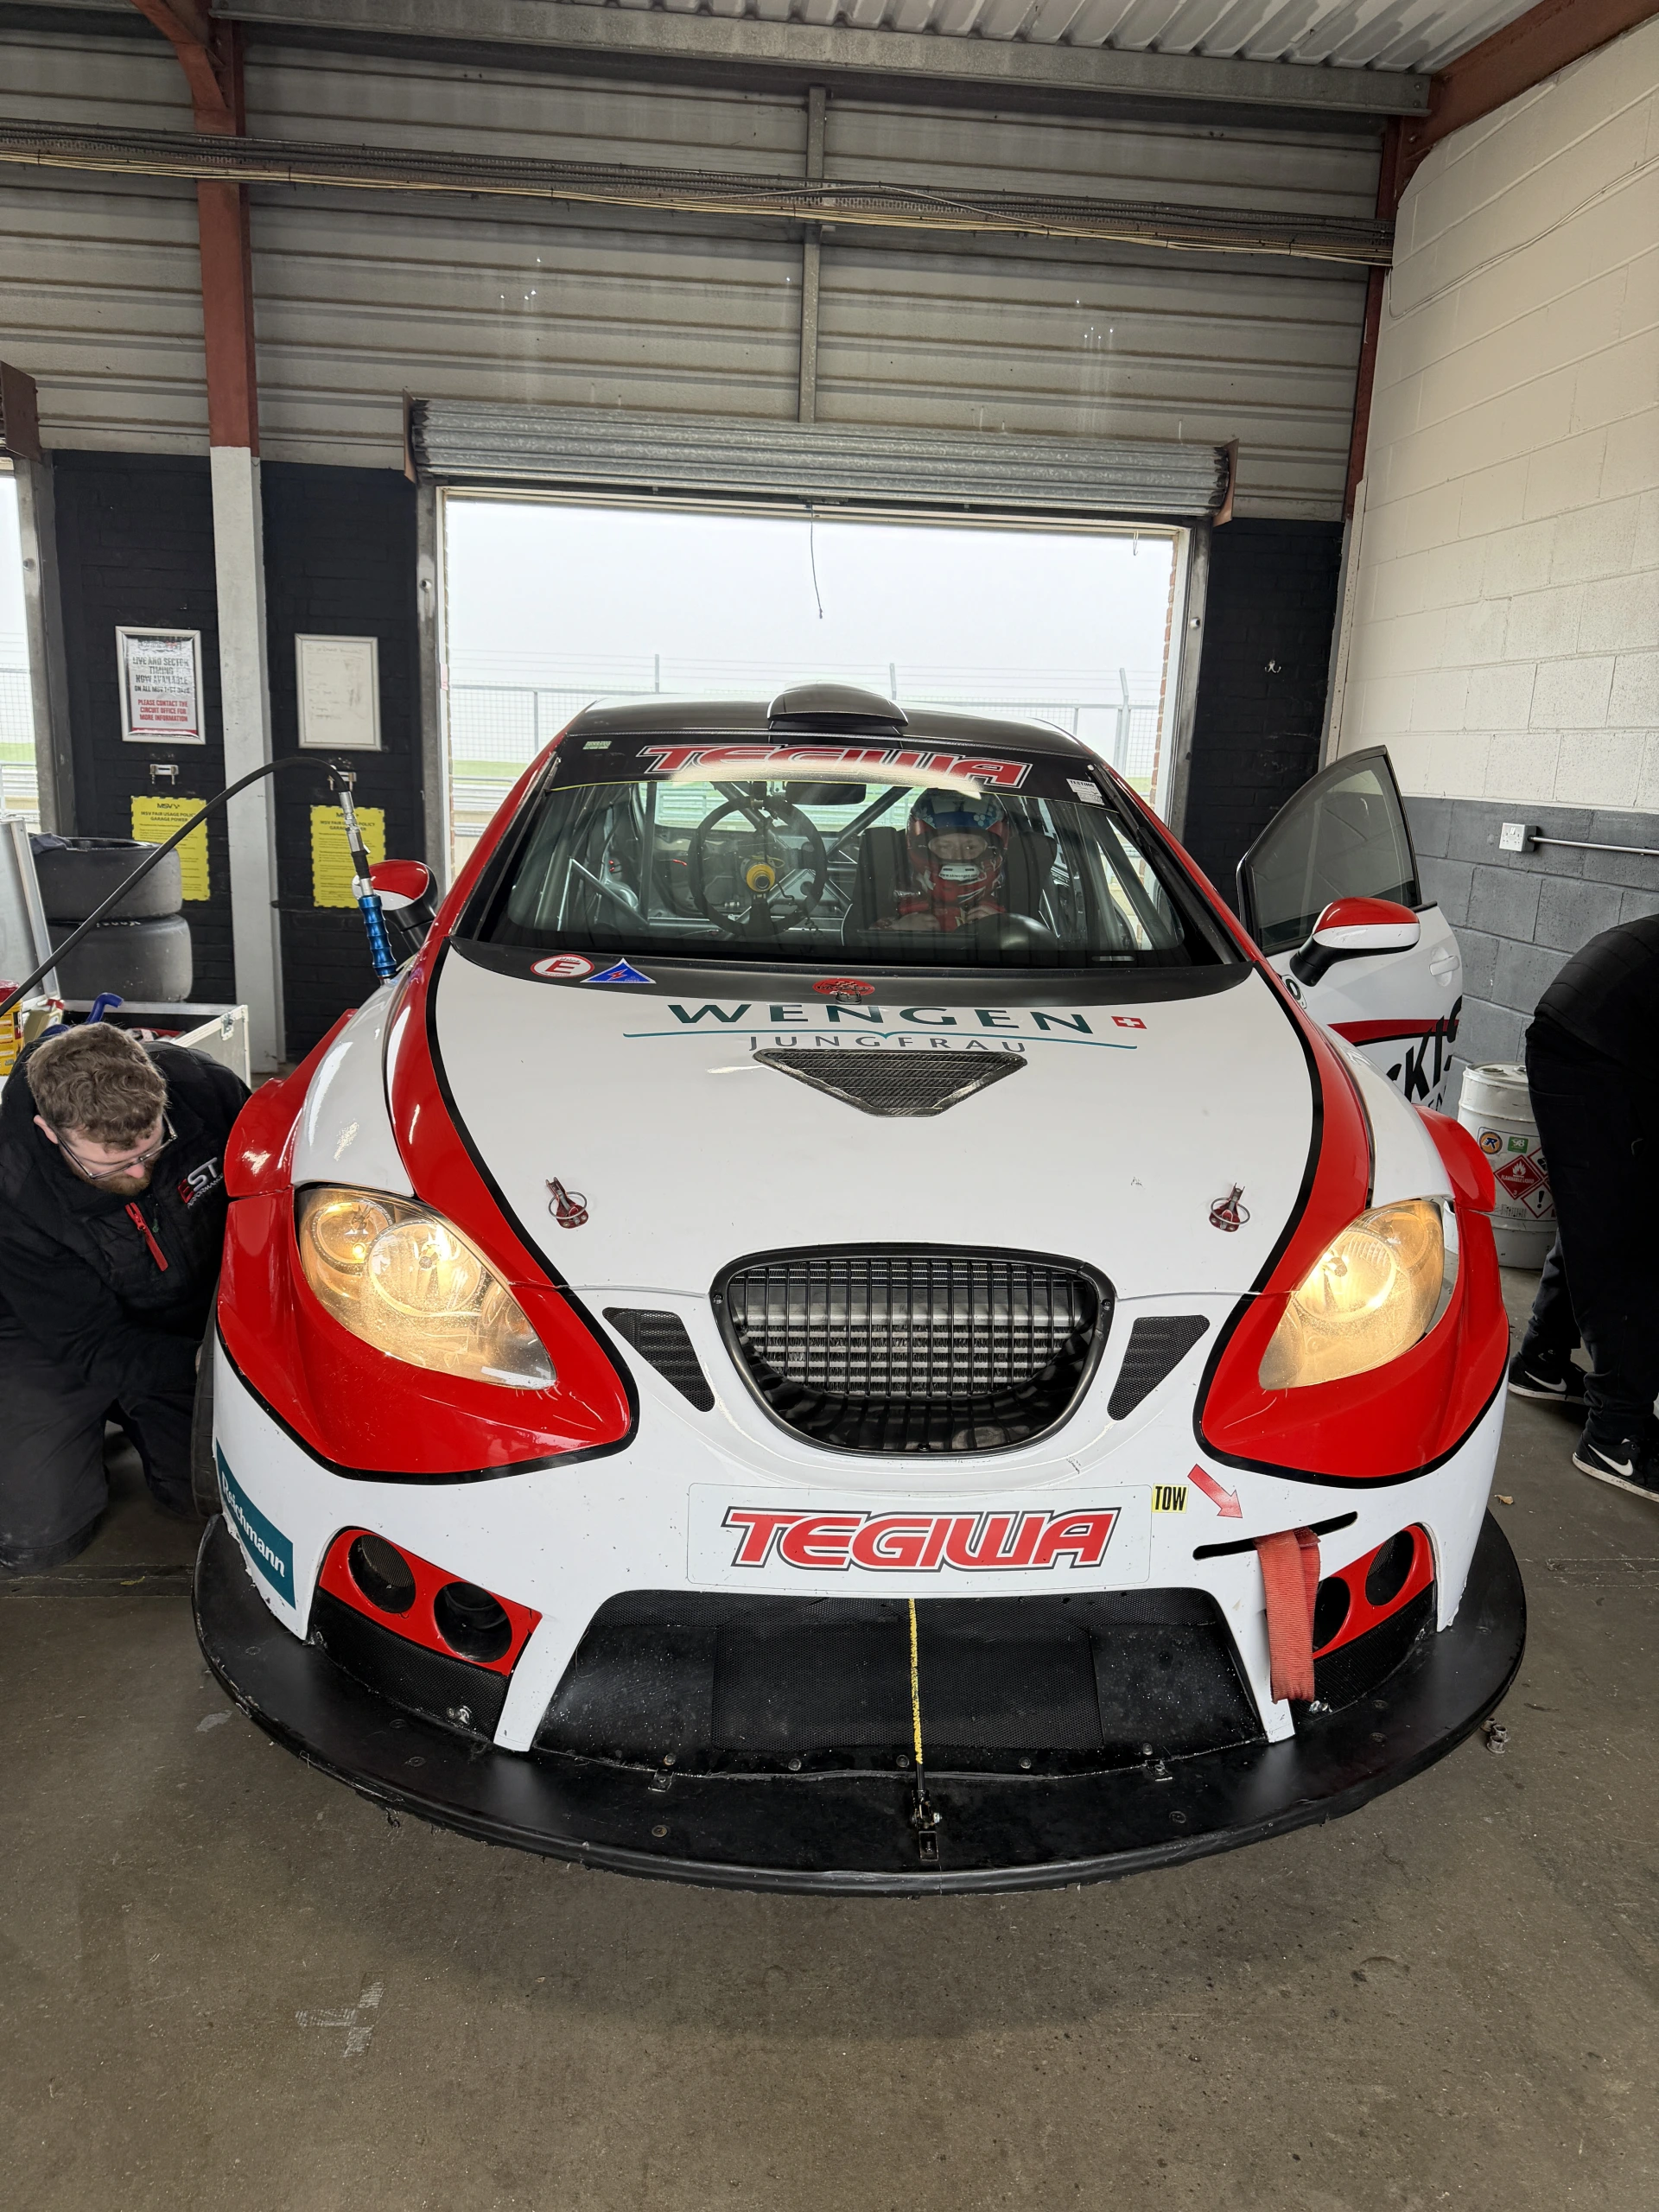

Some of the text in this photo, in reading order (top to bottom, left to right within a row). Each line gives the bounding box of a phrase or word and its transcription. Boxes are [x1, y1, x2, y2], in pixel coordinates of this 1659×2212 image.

[132, 657, 147, 665] LIVE
[544, 960, 582, 974] E
[666, 1002, 1094, 1035] WENGEN
[748, 1035, 1028, 1054] JUNGFRAU
[177, 1157, 217, 1204] EST
[187, 1173, 224, 1209] PERFORMANCE
[1501, 1174, 1522, 1183] FLAMMABLE
[1154, 1485, 1187, 1511] TOW
[221, 1471, 285, 1578] Reichmann
[721, 1505, 1122, 1573] TEGIWA
